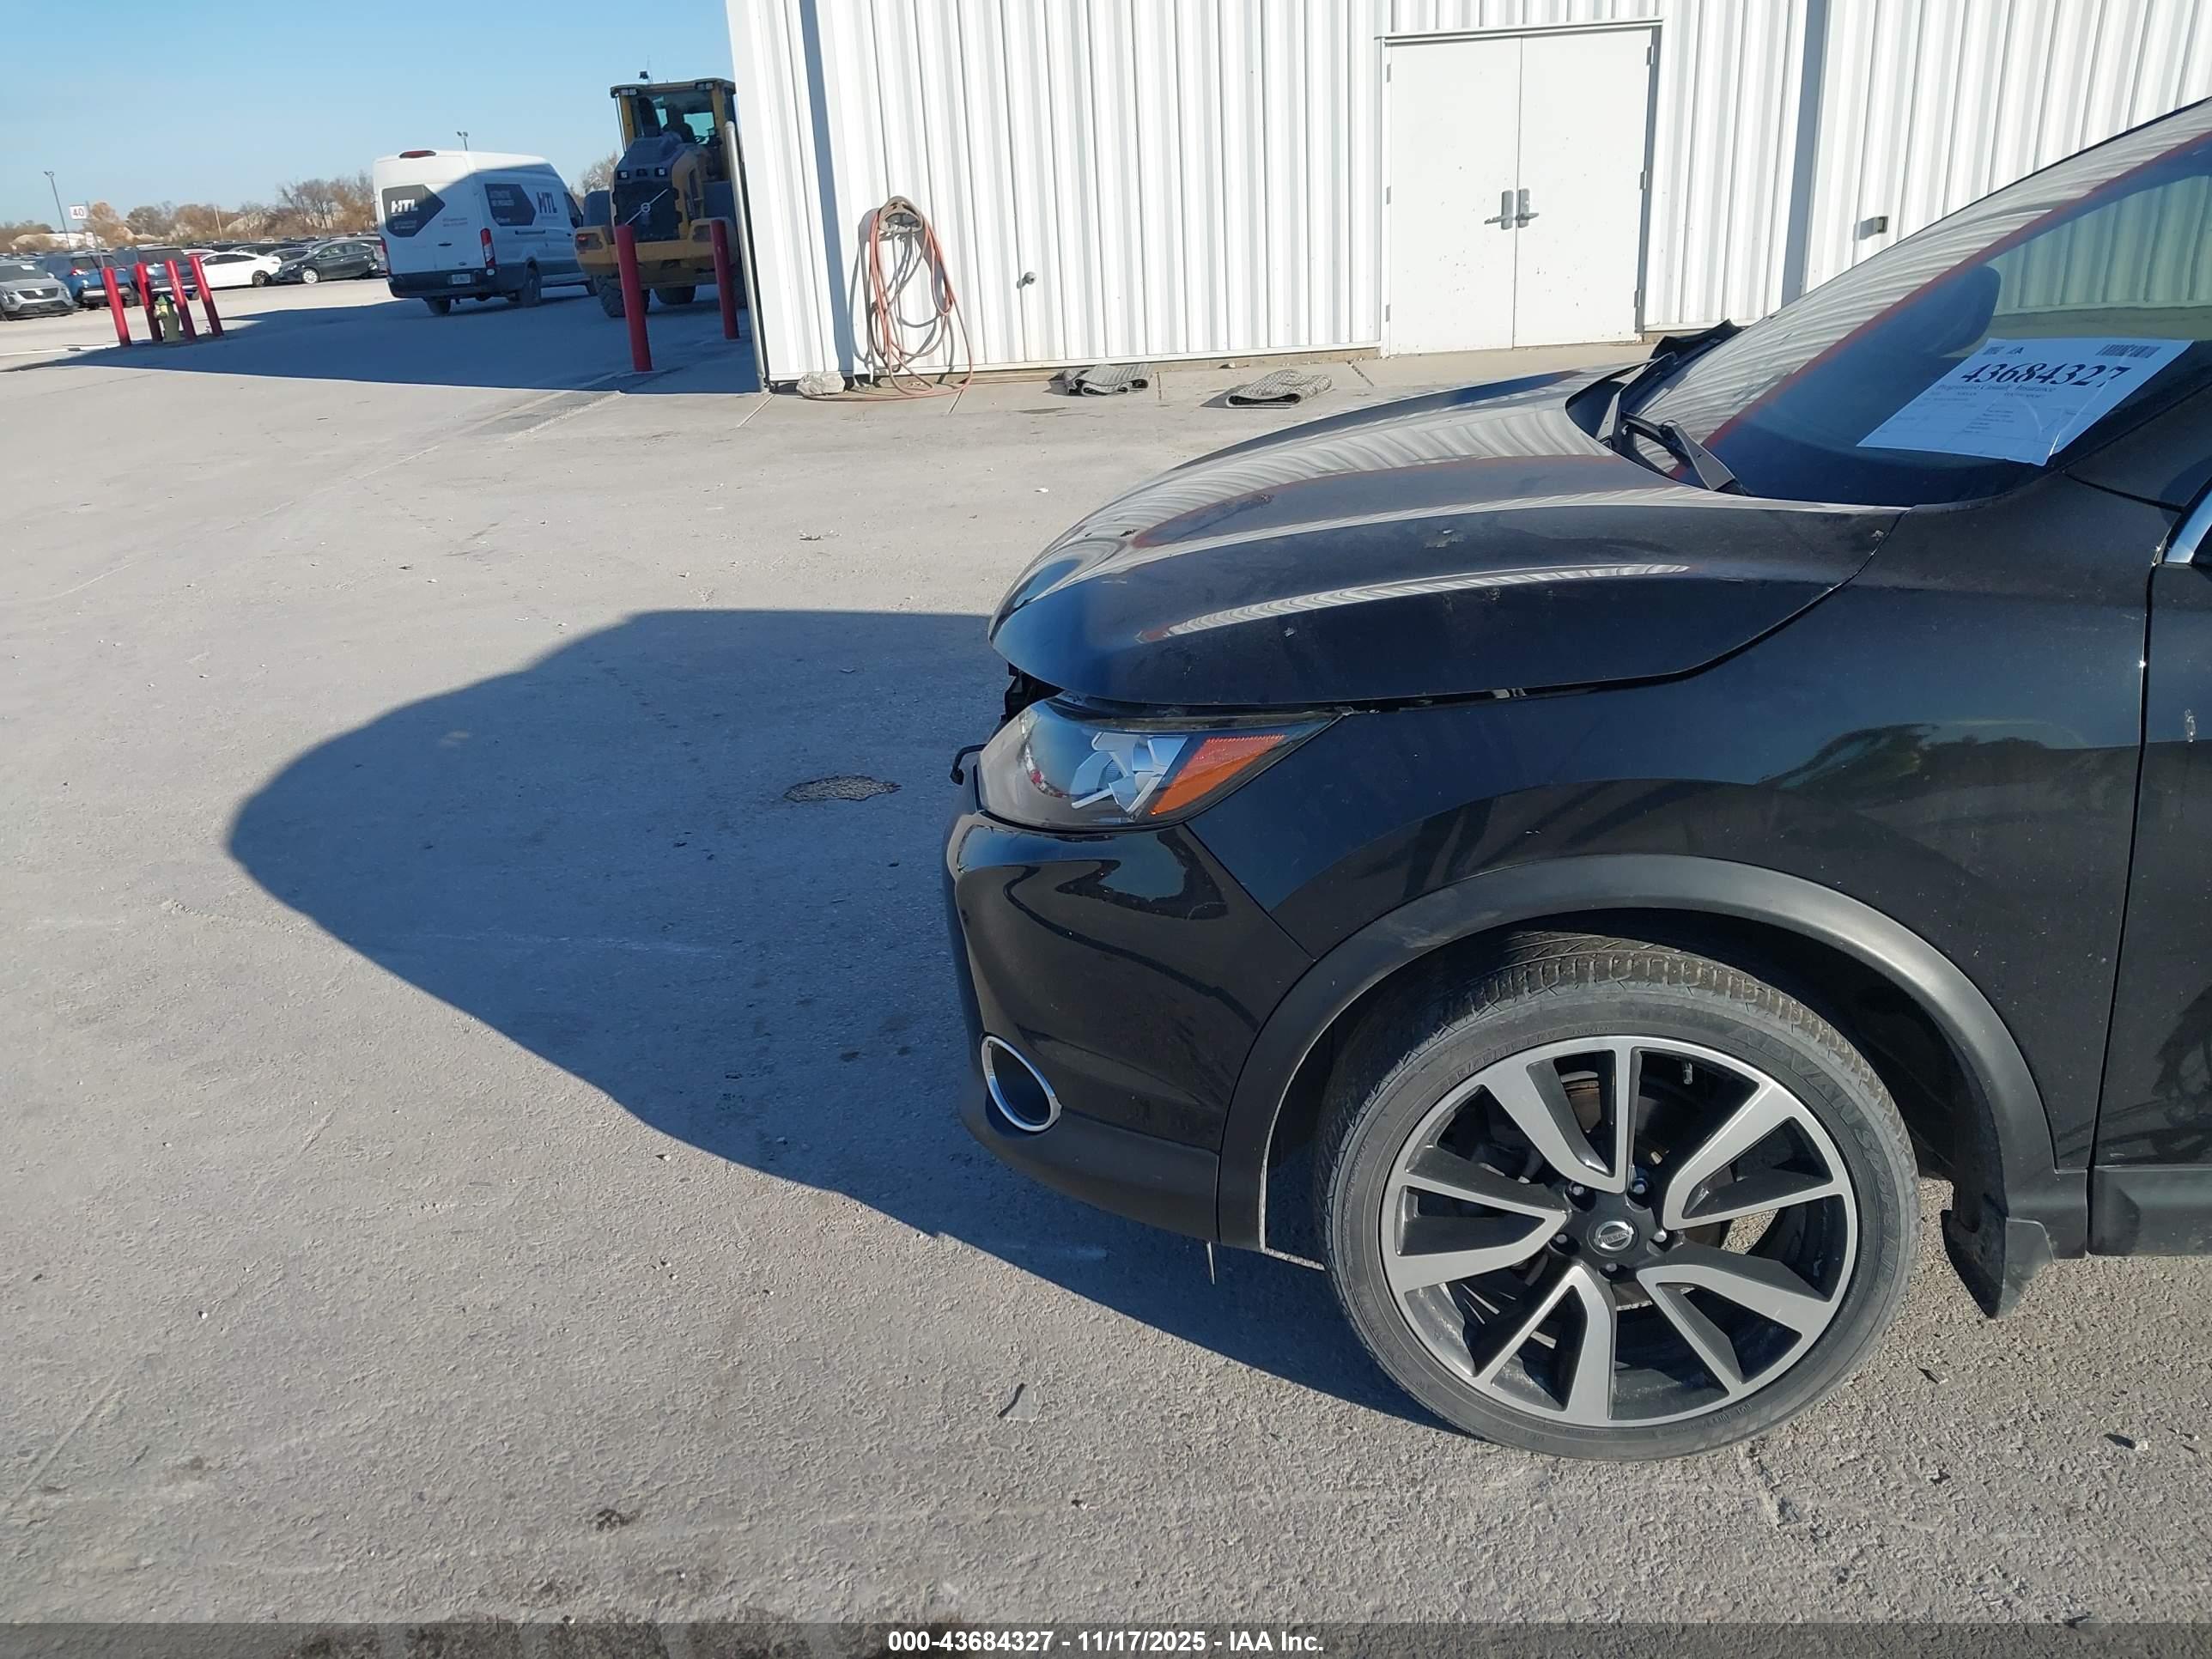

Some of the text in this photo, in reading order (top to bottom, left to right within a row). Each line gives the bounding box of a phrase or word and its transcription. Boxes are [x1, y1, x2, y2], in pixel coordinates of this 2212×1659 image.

[391, 198, 419, 213] HTL
[536, 191, 558, 214] HTL
[73, 207, 84, 216] 40
[1960, 362, 2132, 388] 43684327
[1597, 1230, 1630, 1244] NISSAN
